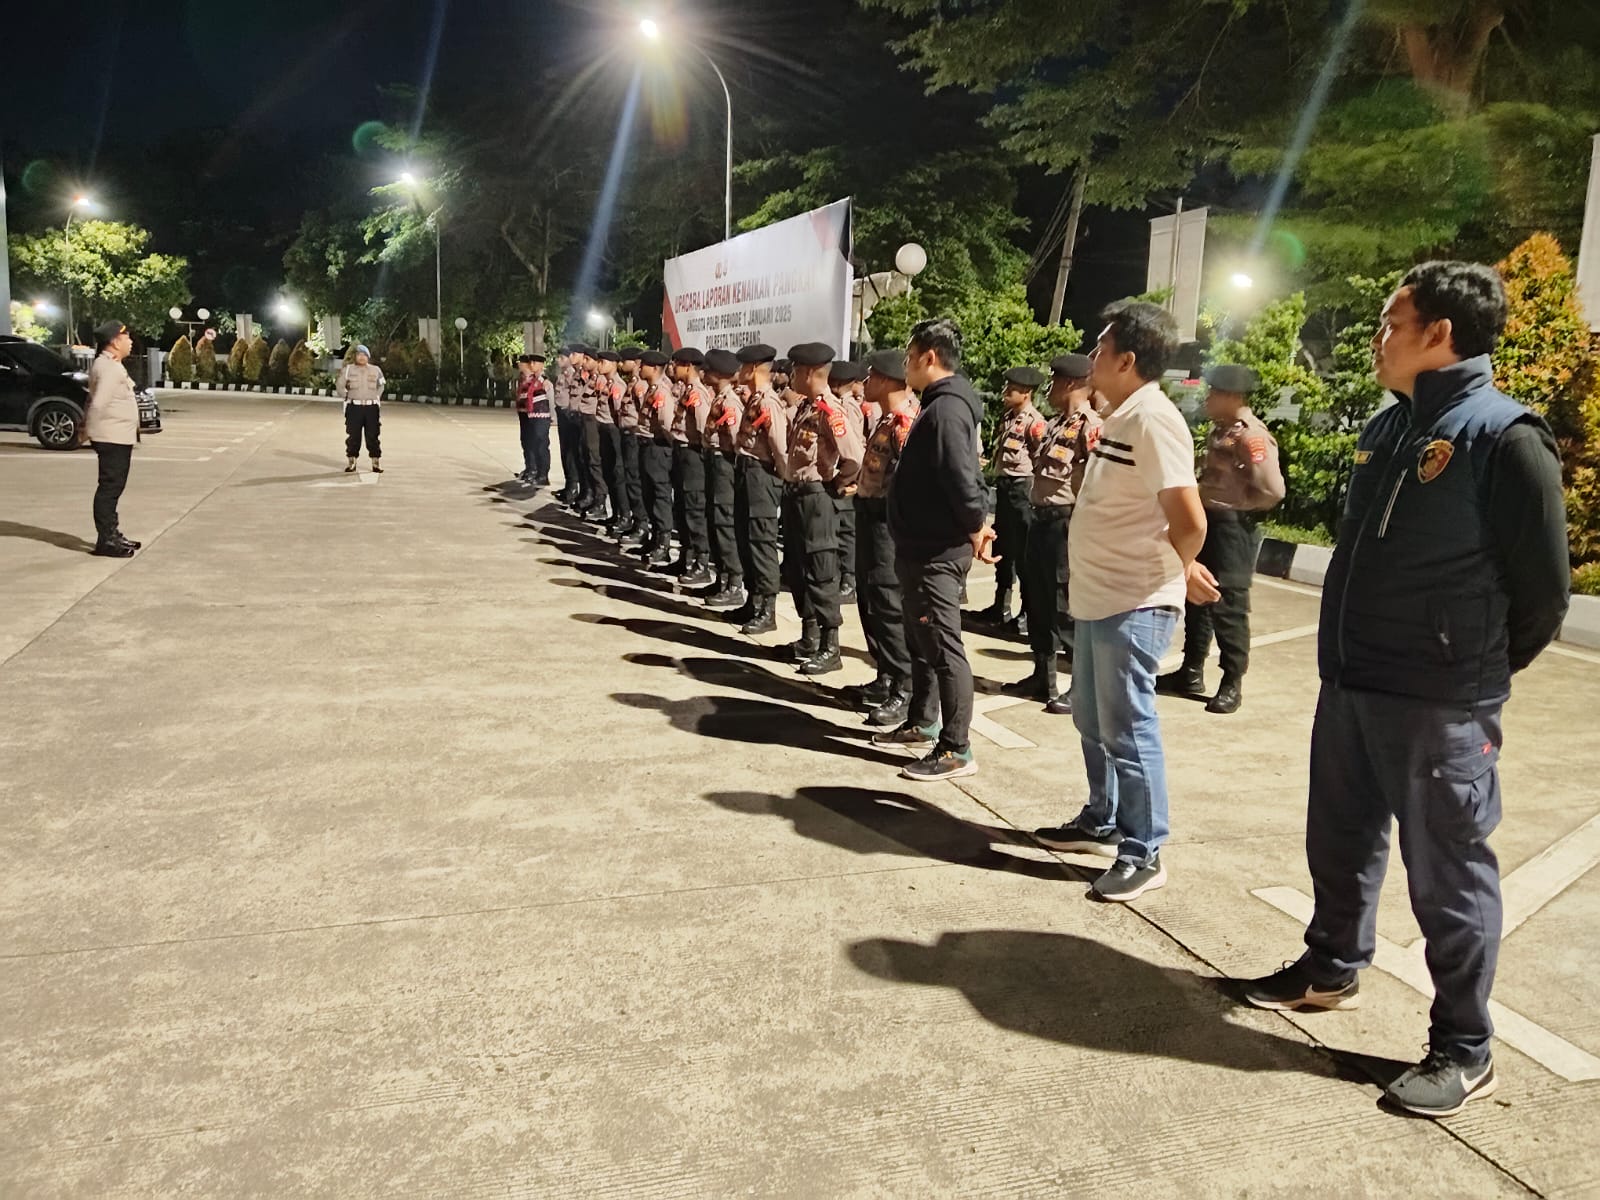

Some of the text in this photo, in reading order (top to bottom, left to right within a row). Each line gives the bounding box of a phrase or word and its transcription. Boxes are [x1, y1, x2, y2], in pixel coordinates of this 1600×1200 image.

[702, 284, 731, 310] LAPORAN
[732, 271, 770, 304] KENAIKAN
[686, 304, 792, 333] ANGGOTA POLRI PERIODE 1 JANUARI 2025
[705, 330, 761, 350] POLRESTA TANGERANG
